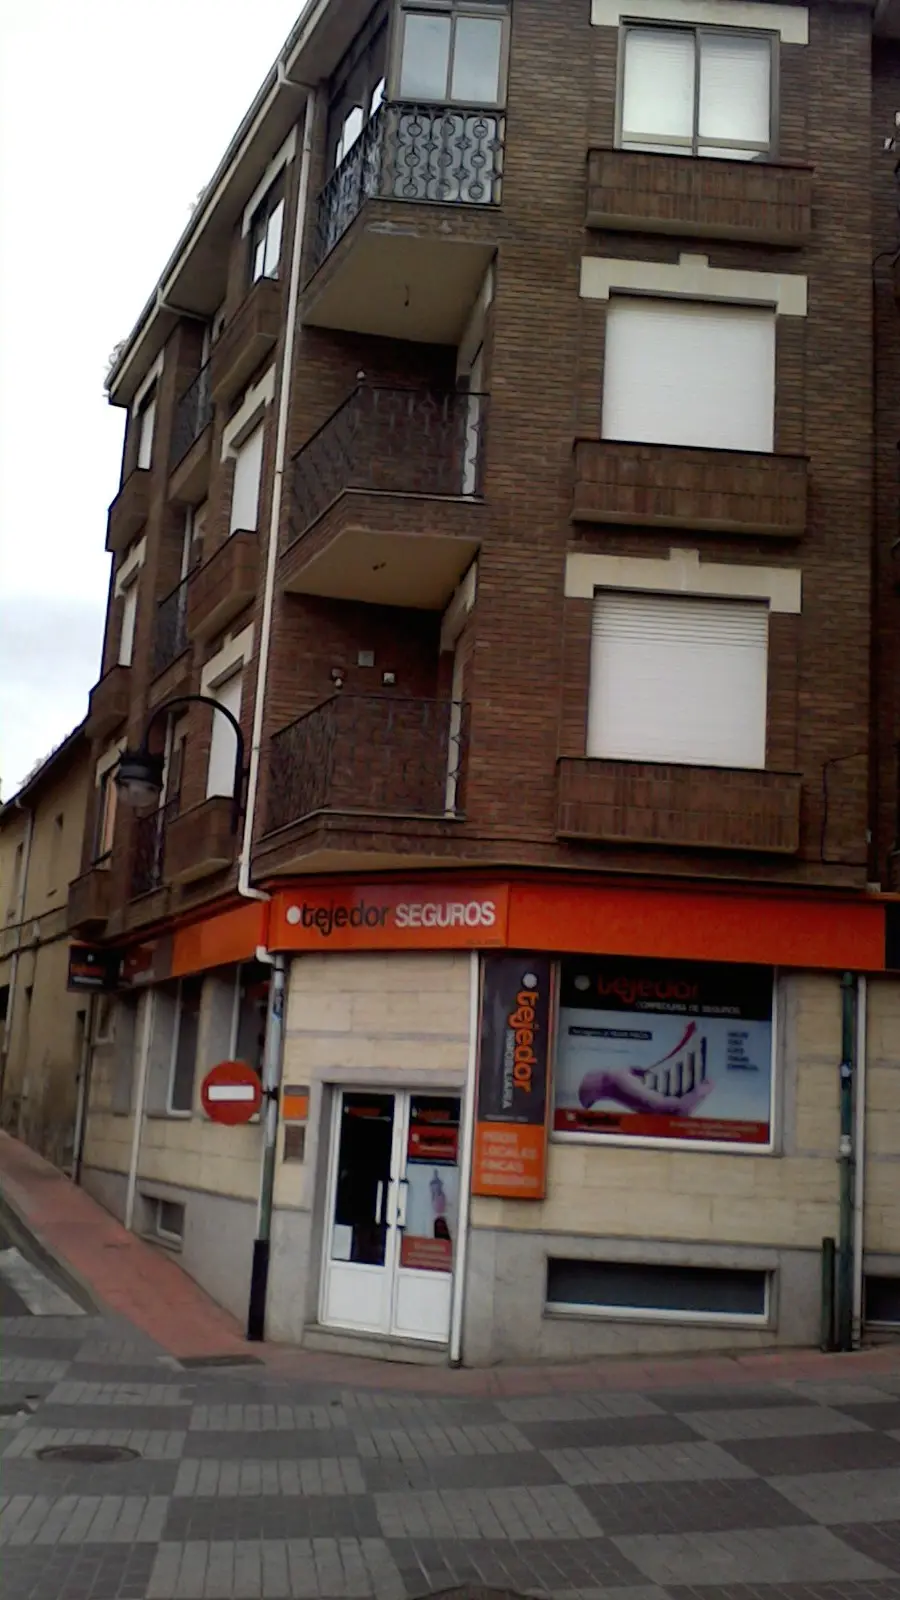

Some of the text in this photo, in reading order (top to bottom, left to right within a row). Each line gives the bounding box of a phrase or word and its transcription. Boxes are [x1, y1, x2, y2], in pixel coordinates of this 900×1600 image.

[302, 900, 496, 937] tejedor SEGUROS
[508, 991, 539, 1092] tejedor
